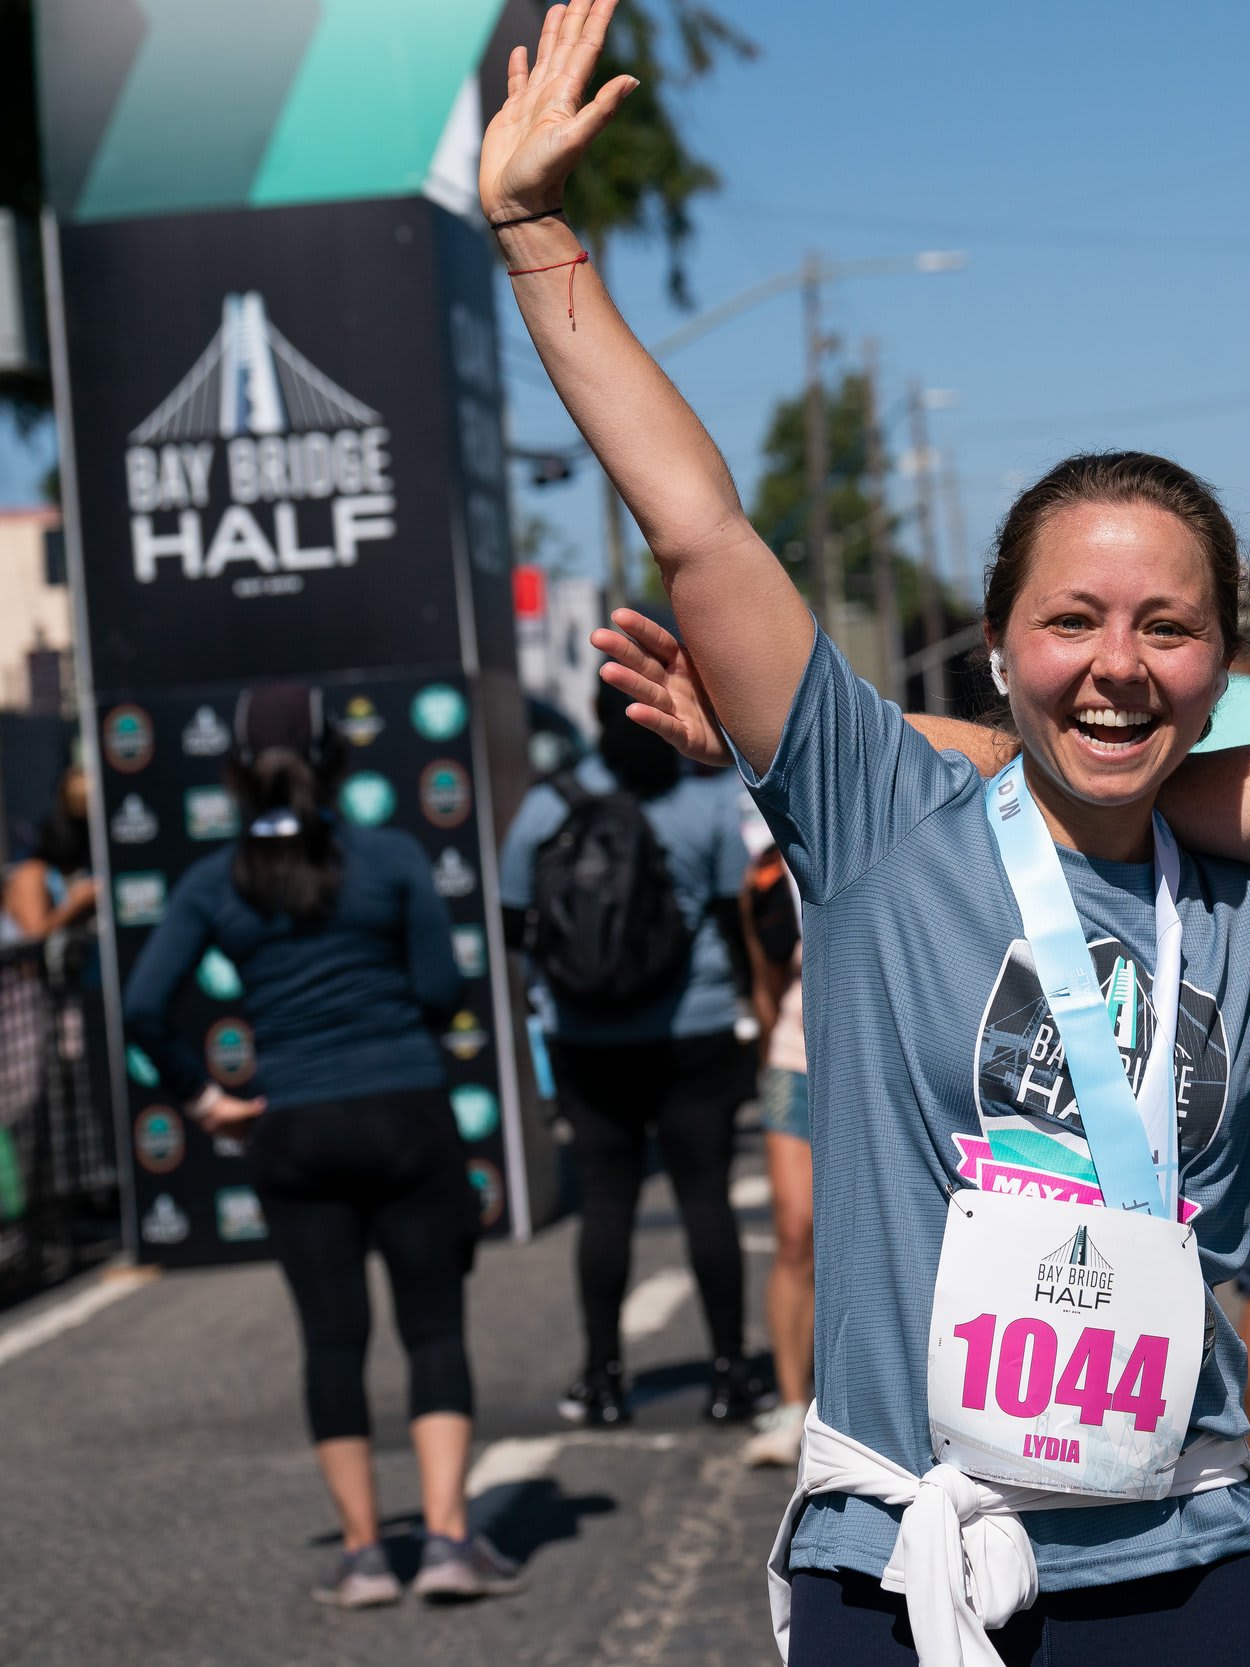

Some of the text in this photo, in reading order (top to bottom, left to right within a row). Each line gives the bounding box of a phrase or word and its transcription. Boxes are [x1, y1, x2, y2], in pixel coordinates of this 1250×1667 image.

[126, 441, 213, 512] BAY
[227, 426, 395, 504] BRIDGE
[130, 493, 396, 583] HALF
[1030, 1023, 1066, 1070] BA
[991, 1174, 1065, 1201] MAY
[1034, 1283, 1112, 1310] HALF
[1037, 1263, 1115, 1291] BAY BRIDGE
[953, 1312, 1170, 1433] 1044
[1022, 1433, 1080, 1464] LYDIA
